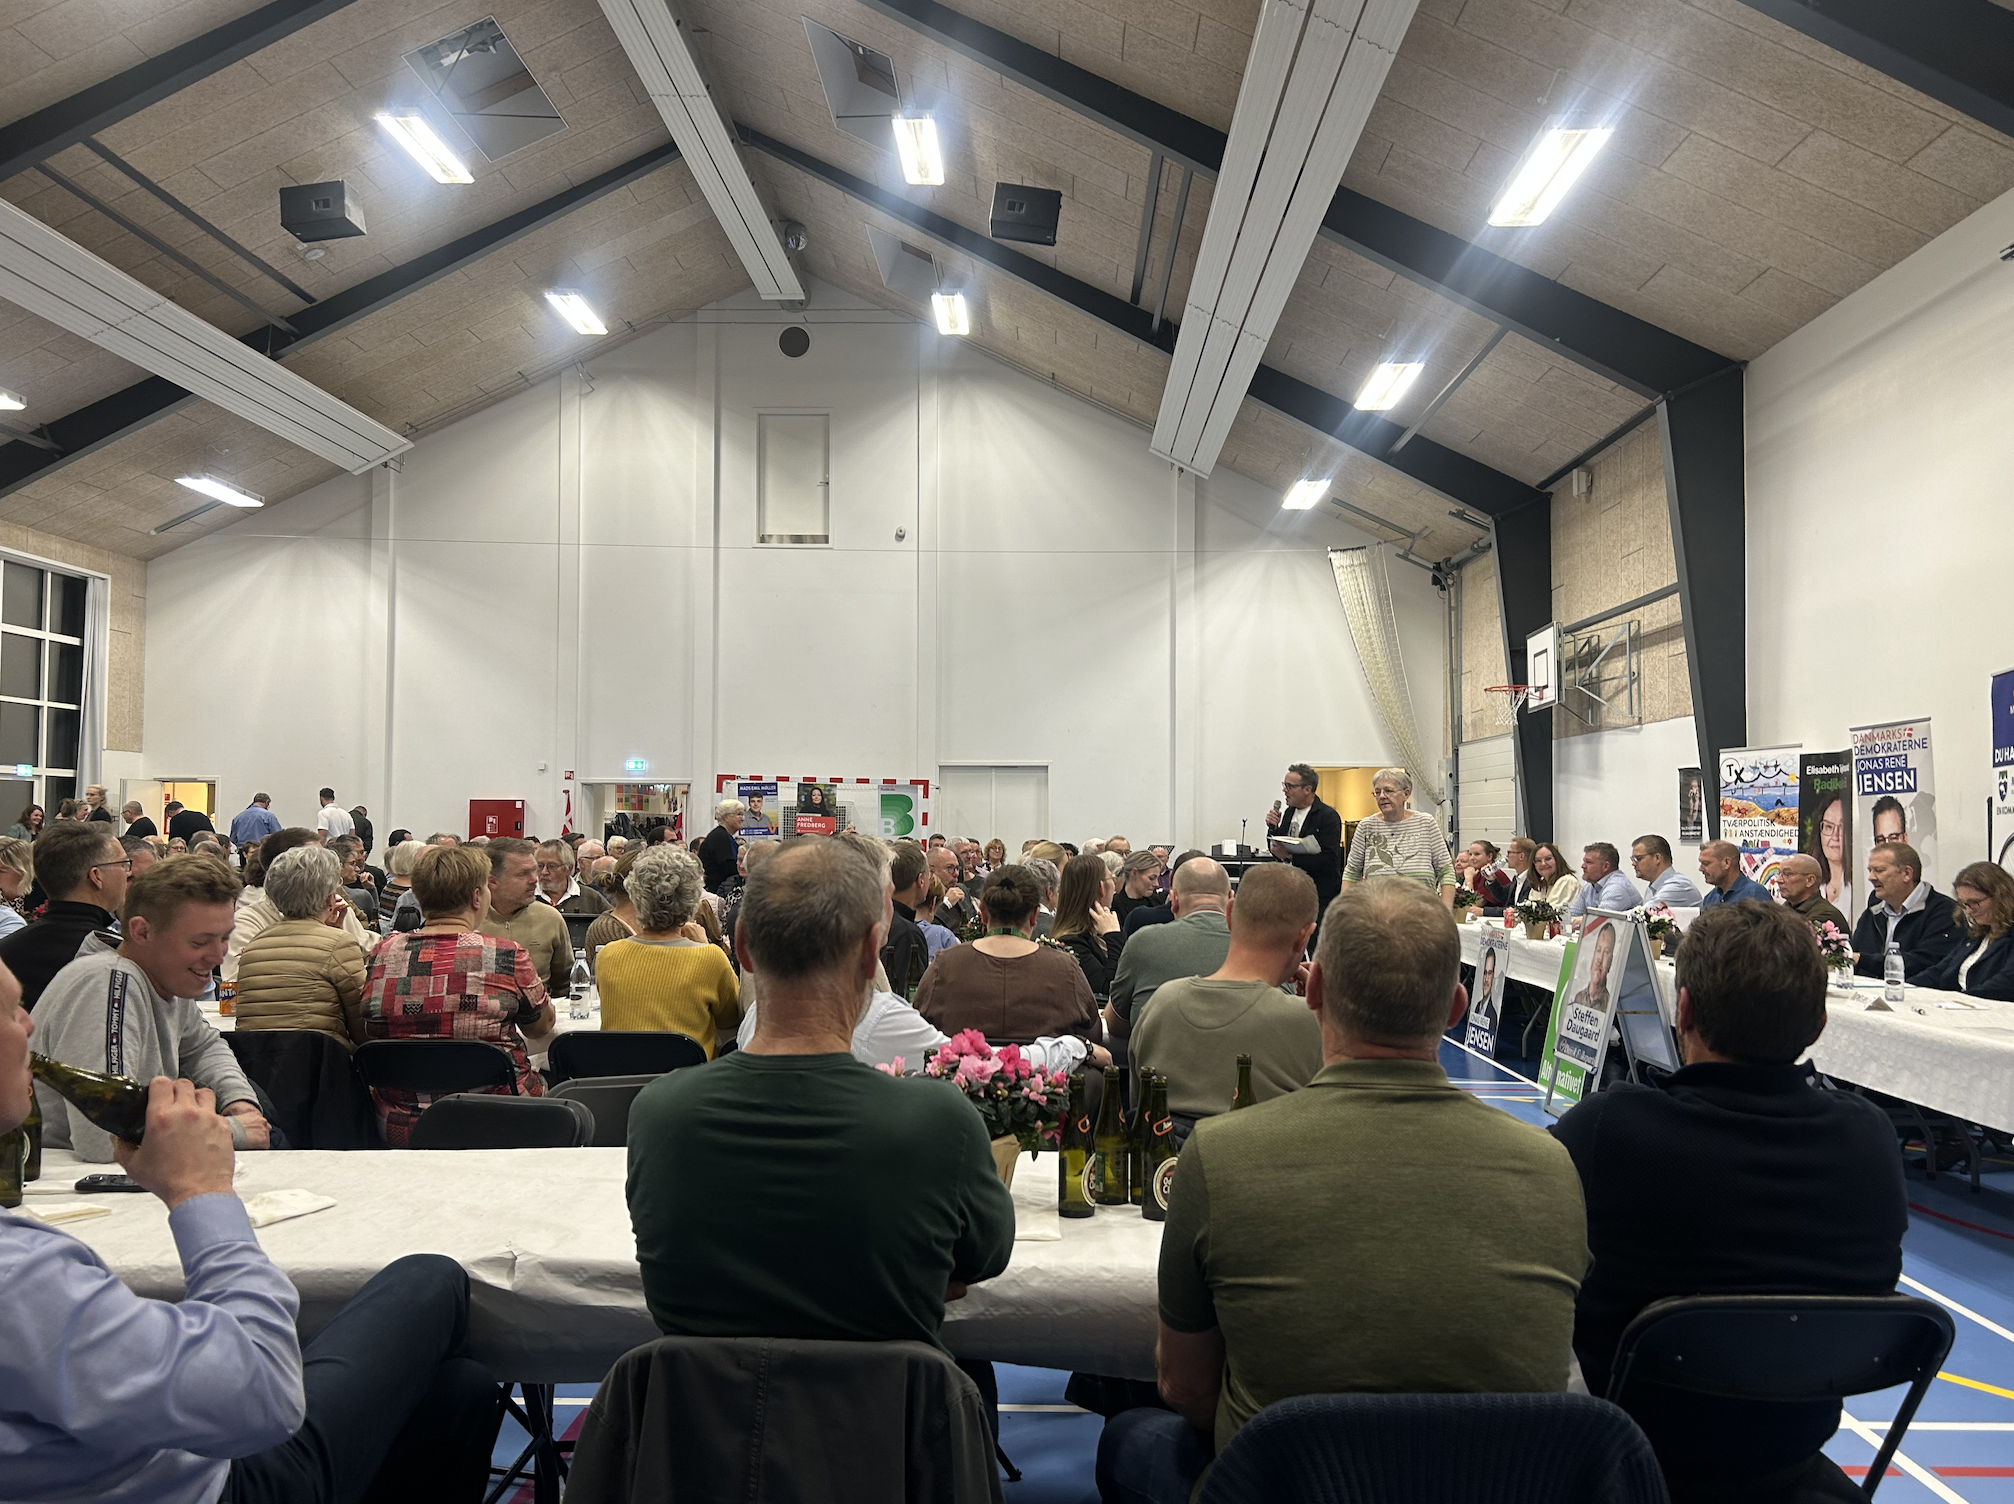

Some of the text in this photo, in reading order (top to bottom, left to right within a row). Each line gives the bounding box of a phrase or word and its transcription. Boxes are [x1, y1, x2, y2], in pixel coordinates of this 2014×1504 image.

[1853, 728, 1902, 744] DANMARKS
[1854, 738, 1928, 756] DEMOKRATERNE
[1995, 748, 2003, 763] DU
[1806, 764, 1839, 775] Elisabeth
[1856, 758, 1883, 773] JONAS
[1885, 754, 1906, 768] RENÉ
[1858, 770, 1915, 795] JENSEN
[1723, 819, 1776, 828] TVÆRPOLITISK
[1739, 829, 1799, 838] ANSTÆNDIGHED
[111, 1008, 120, 1033] TOMMY
[1573, 1007, 1599, 1028] Steffen
[1467, 1026, 1494, 1052] JENSEN
[1566, 1019, 1601, 1042] Daugaard
[111, 1044, 119, 1074] HILFIGER
[1541, 1060, 1581, 1094] Altnativet
